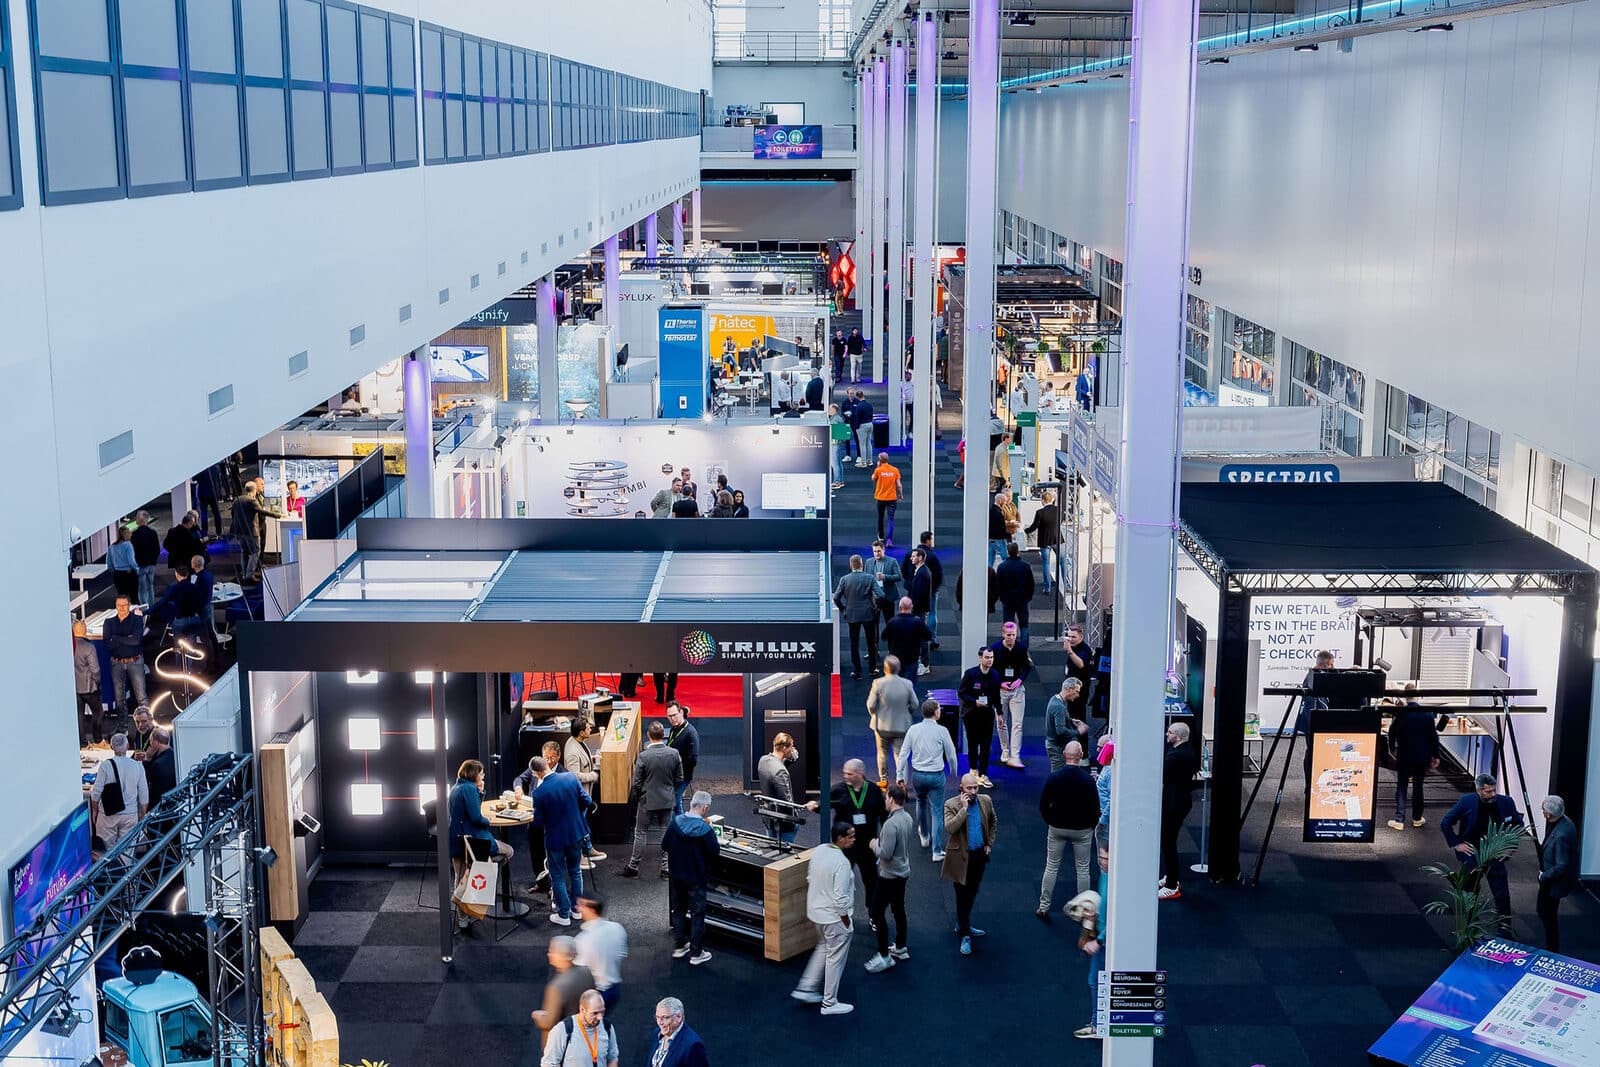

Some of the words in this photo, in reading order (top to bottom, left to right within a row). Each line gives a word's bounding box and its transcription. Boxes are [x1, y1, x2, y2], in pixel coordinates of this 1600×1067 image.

[618, 293, 653, 302] SYLUX
[1254, 604, 1283, 615] NEW
[1287, 604, 1331, 615] RETAIL
[1249, 620, 1272, 631] RTS
[1275, 620, 1287, 631] IN
[1291, 620, 1317, 631] THE
[1267, 634, 1295, 645] NOT
[1298, 634, 1315, 645] AT
[718, 641, 817, 653] TRILUX
[721, 652, 761, 660] SIMPLIFY
[763, 652, 785, 660] YOUR
[46, 873, 67, 902] FUTURE
[1486, 939, 1528, 956] future
[1566, 963, 1584, 973] NOV
[1530, 965, 1595, 988] GORINCHEM
